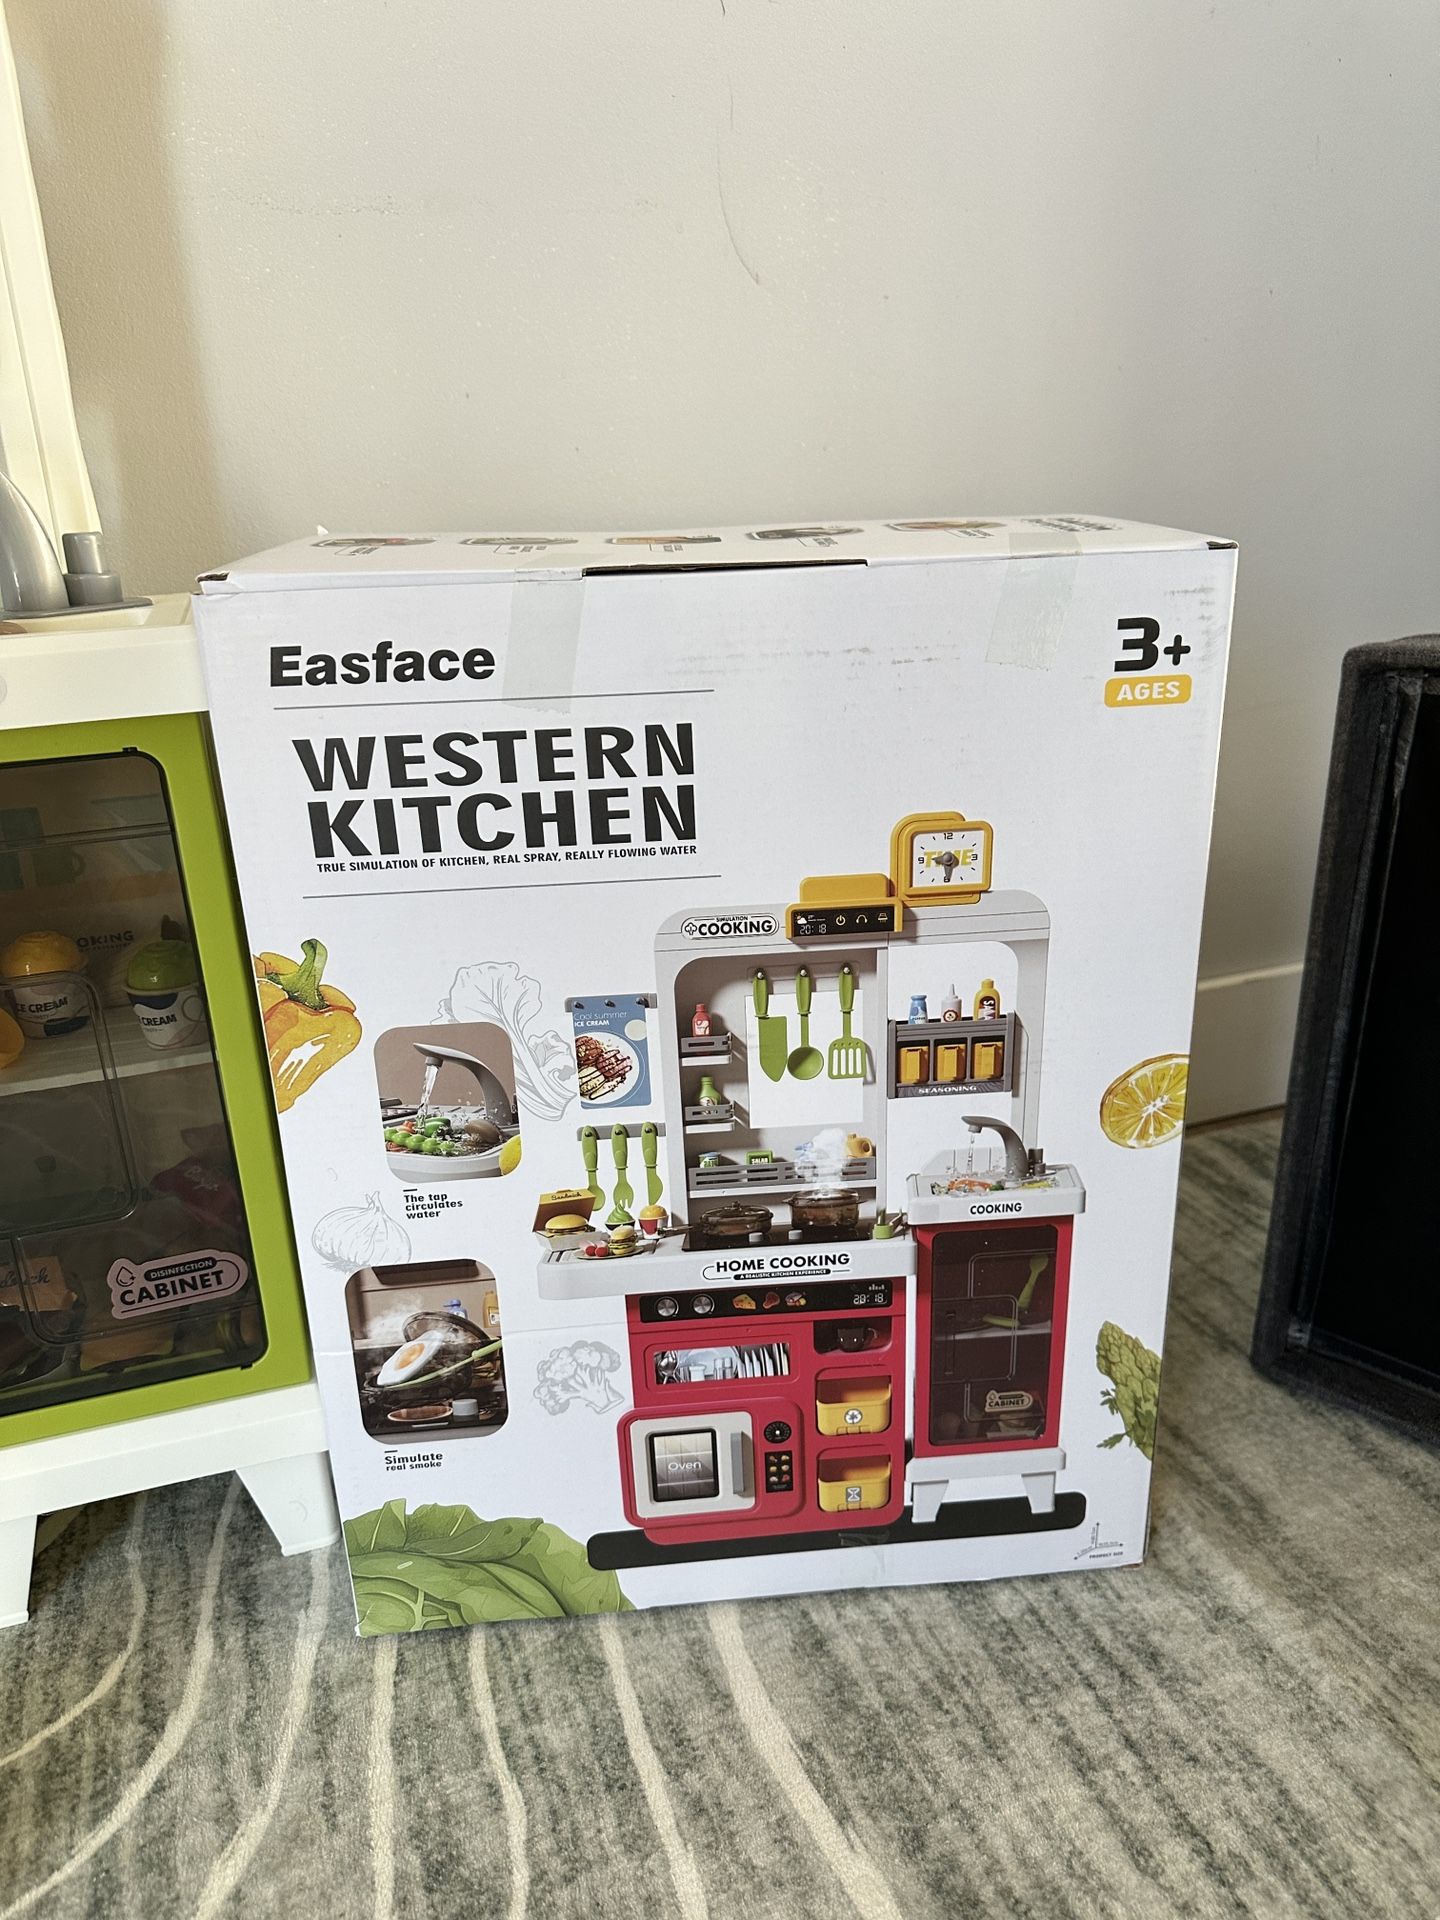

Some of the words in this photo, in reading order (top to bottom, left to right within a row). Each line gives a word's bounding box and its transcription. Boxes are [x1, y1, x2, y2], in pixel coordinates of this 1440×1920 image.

[1114, 617, 1191, 672] 3+
[270, 641, 496, 688] Easface
[1116, 681, 1180, 701] AGES
[291, 722, 695, 792] WESTERN
[307, 784, 697, 859] KITCHEN
[943, 832, 954, 840] 12
[317, 862, 347, 874] TRUE
[349, 859, 418, 872] SIMULATION
[421, 858, 436, 868] OF
[439, 854, 489, 868] KITCHEN,
[493, 852, 520, 865] REAL
[523, 851, 562, 864] SPRAY,
[565, 849, 604, 861] REALLY
[608, 847, 656, 859] FLOWING
[660, 845, 697, 856] WATER
[917, 856, 925, 864] 9
[924, 848, 974, 868] TIE
[971, 853, 978, 861] 3
[716, 915, 749, 923] SIMULATION
[698, 919, 773, 936] COOKING
[76, 930, 134, 948] OKING
[28, 996, 70, 1013] CREAM
[141, 1014, 178, 1026] CREAM
[573, 1012, 592, 1021] Cool
[594, 1010, 628, 1020] summer
[586, 1019, 610, 1027] CREAM
[918, 1084, 977, 1094] SEASONING
[403, 1194, 425, 1203] The
[428, 1193, 448, 1201] tap
[551, 1191, 583, 1201] Sandwich
[405, 1200, 464, 1211] circulates
[969, 1202, 1023, 1215] COOKING
[406, 1210, 441, 1219] water
[150, 1258, 213, 1280] DISINFECTION
[716, 1258, 765, 1273] HOME
[769, 1252, 851, 1270] COOKING
[119, 1269, 225, 1307] CABINET
[988, 1398, 1025, 1408] CABINET
[384, 1452, 443, 1465] Simulate
[386, 1463, 406, 1471] real
[409, 1460, 442, 1470] smoke
[668, 1461, 702, 1470] Oven
